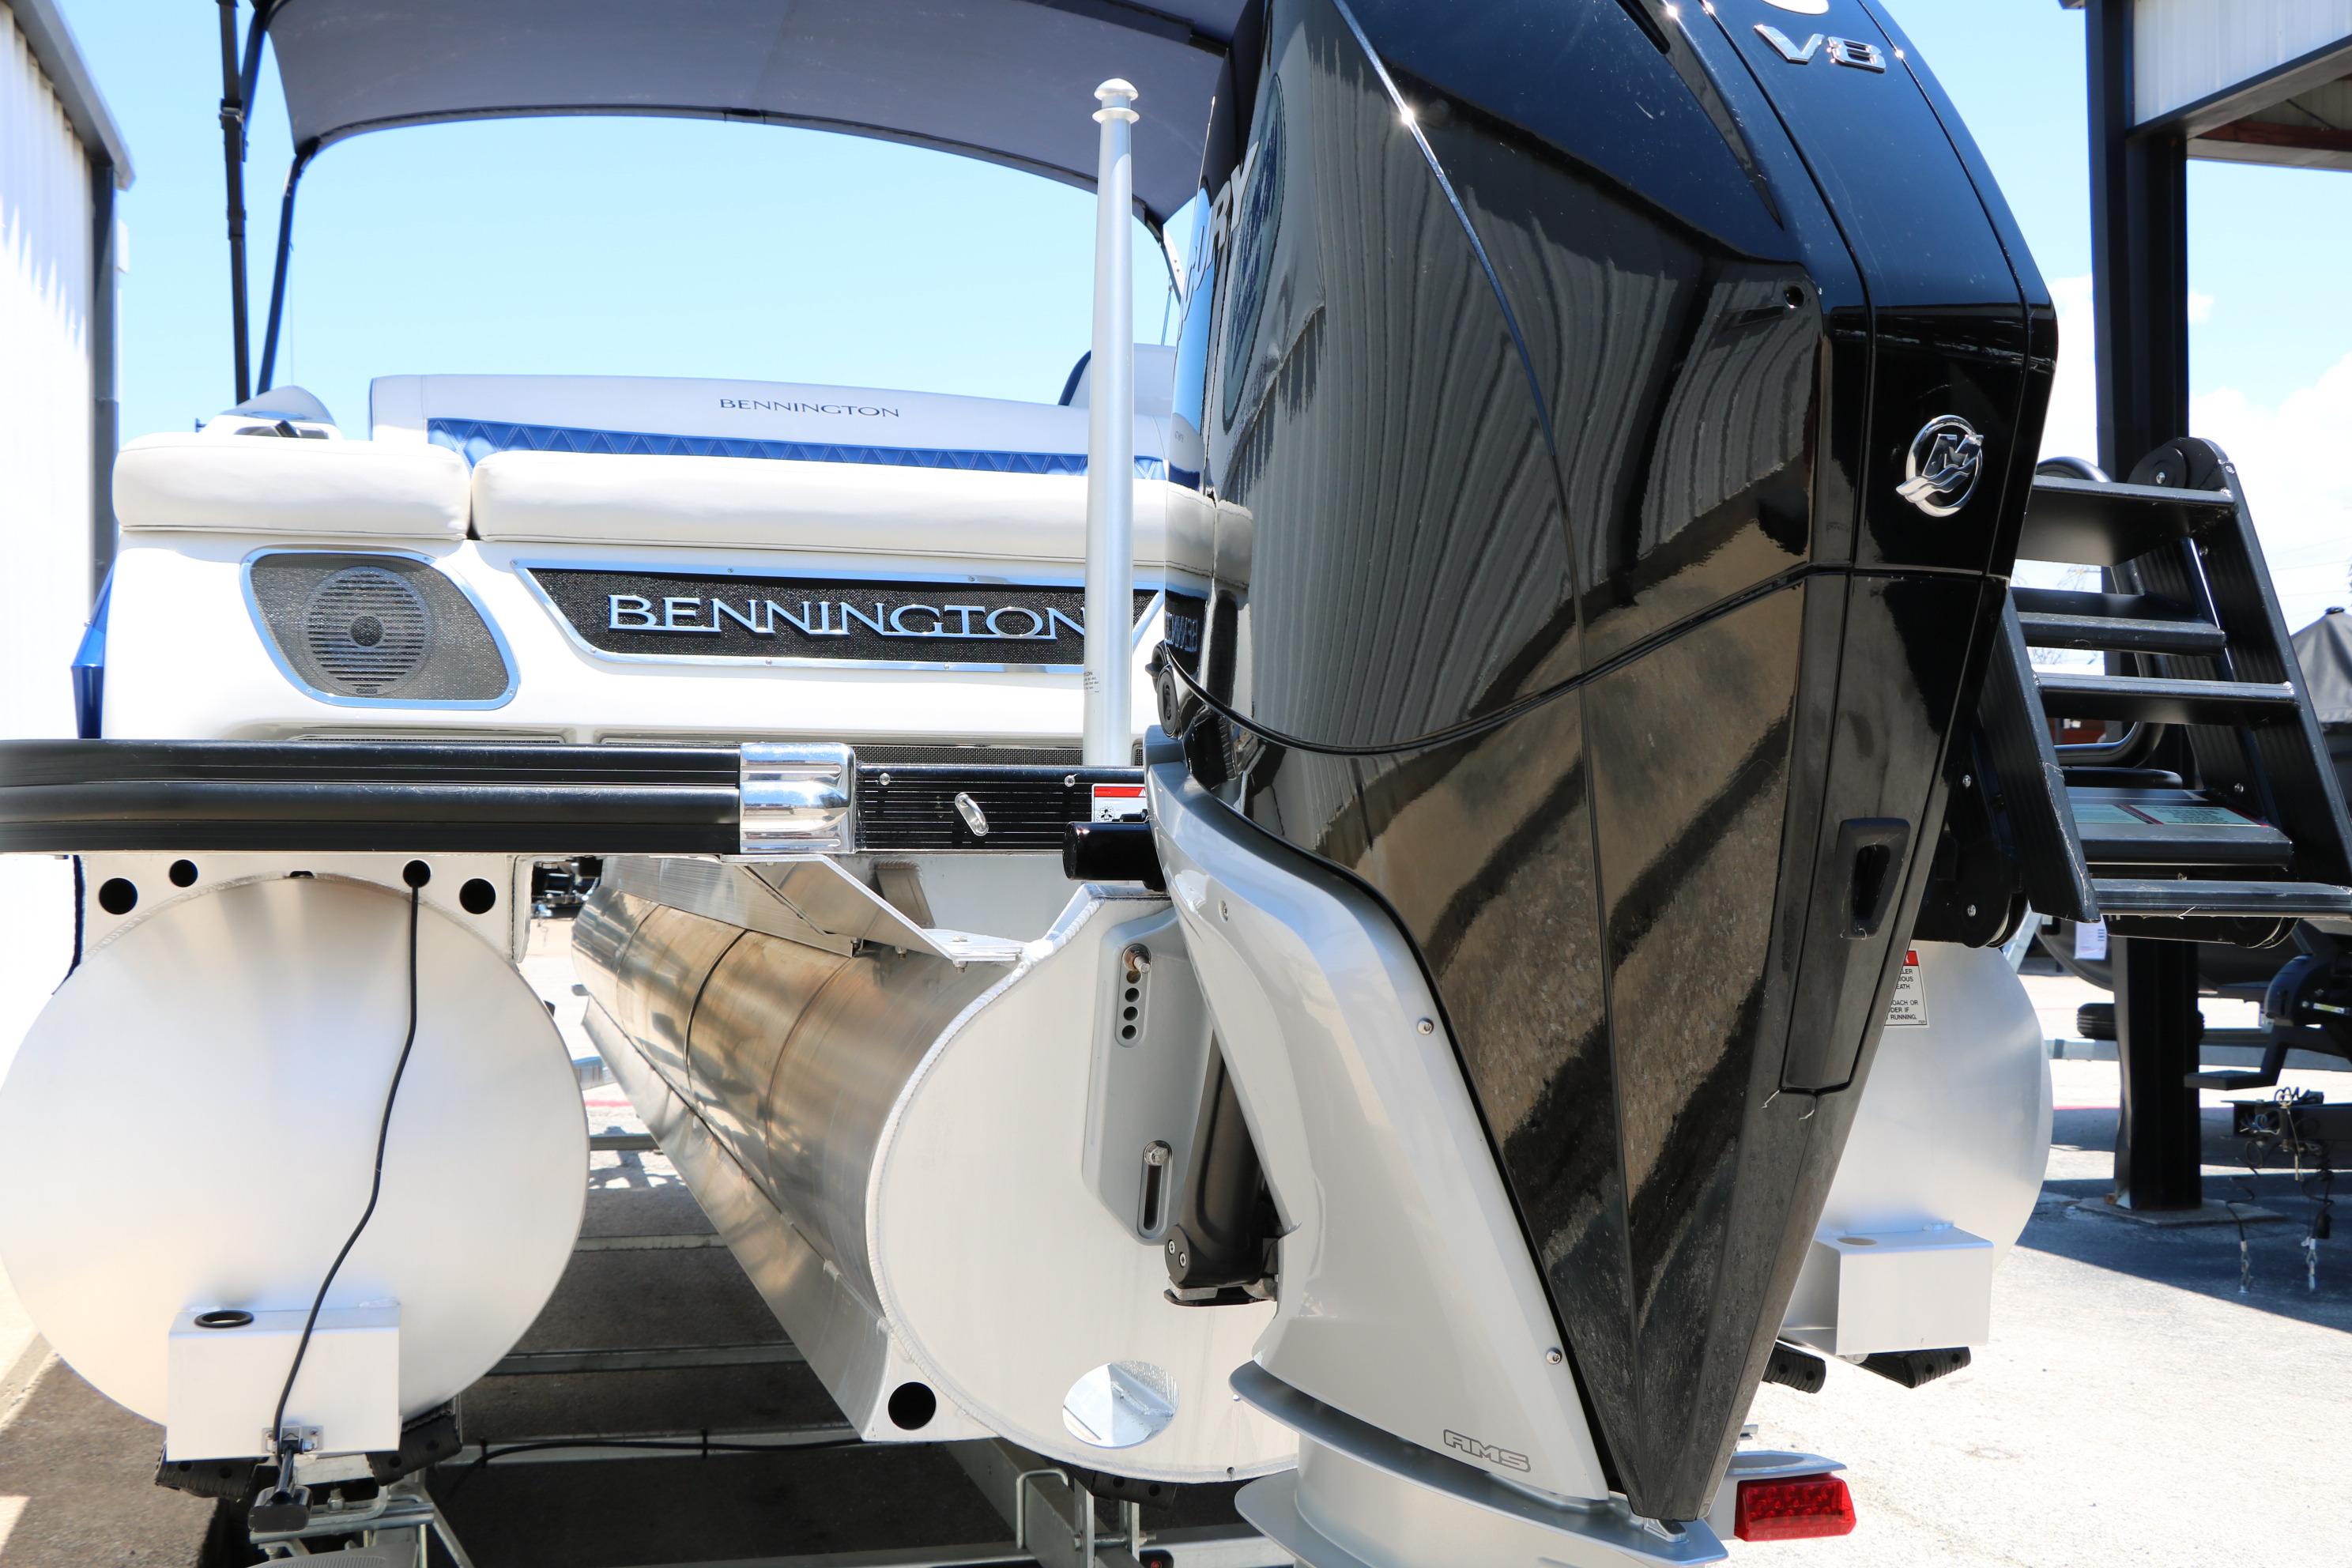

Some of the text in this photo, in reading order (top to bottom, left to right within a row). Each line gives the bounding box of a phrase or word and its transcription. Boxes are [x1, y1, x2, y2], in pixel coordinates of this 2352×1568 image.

[1752, 24, 1886, 74] V8
[719, 398, 900, 418] BENNINGTON
[607, 594, 1085, 640] BENNINGTON
[1443, 1429, 1532, 1473] AMS
